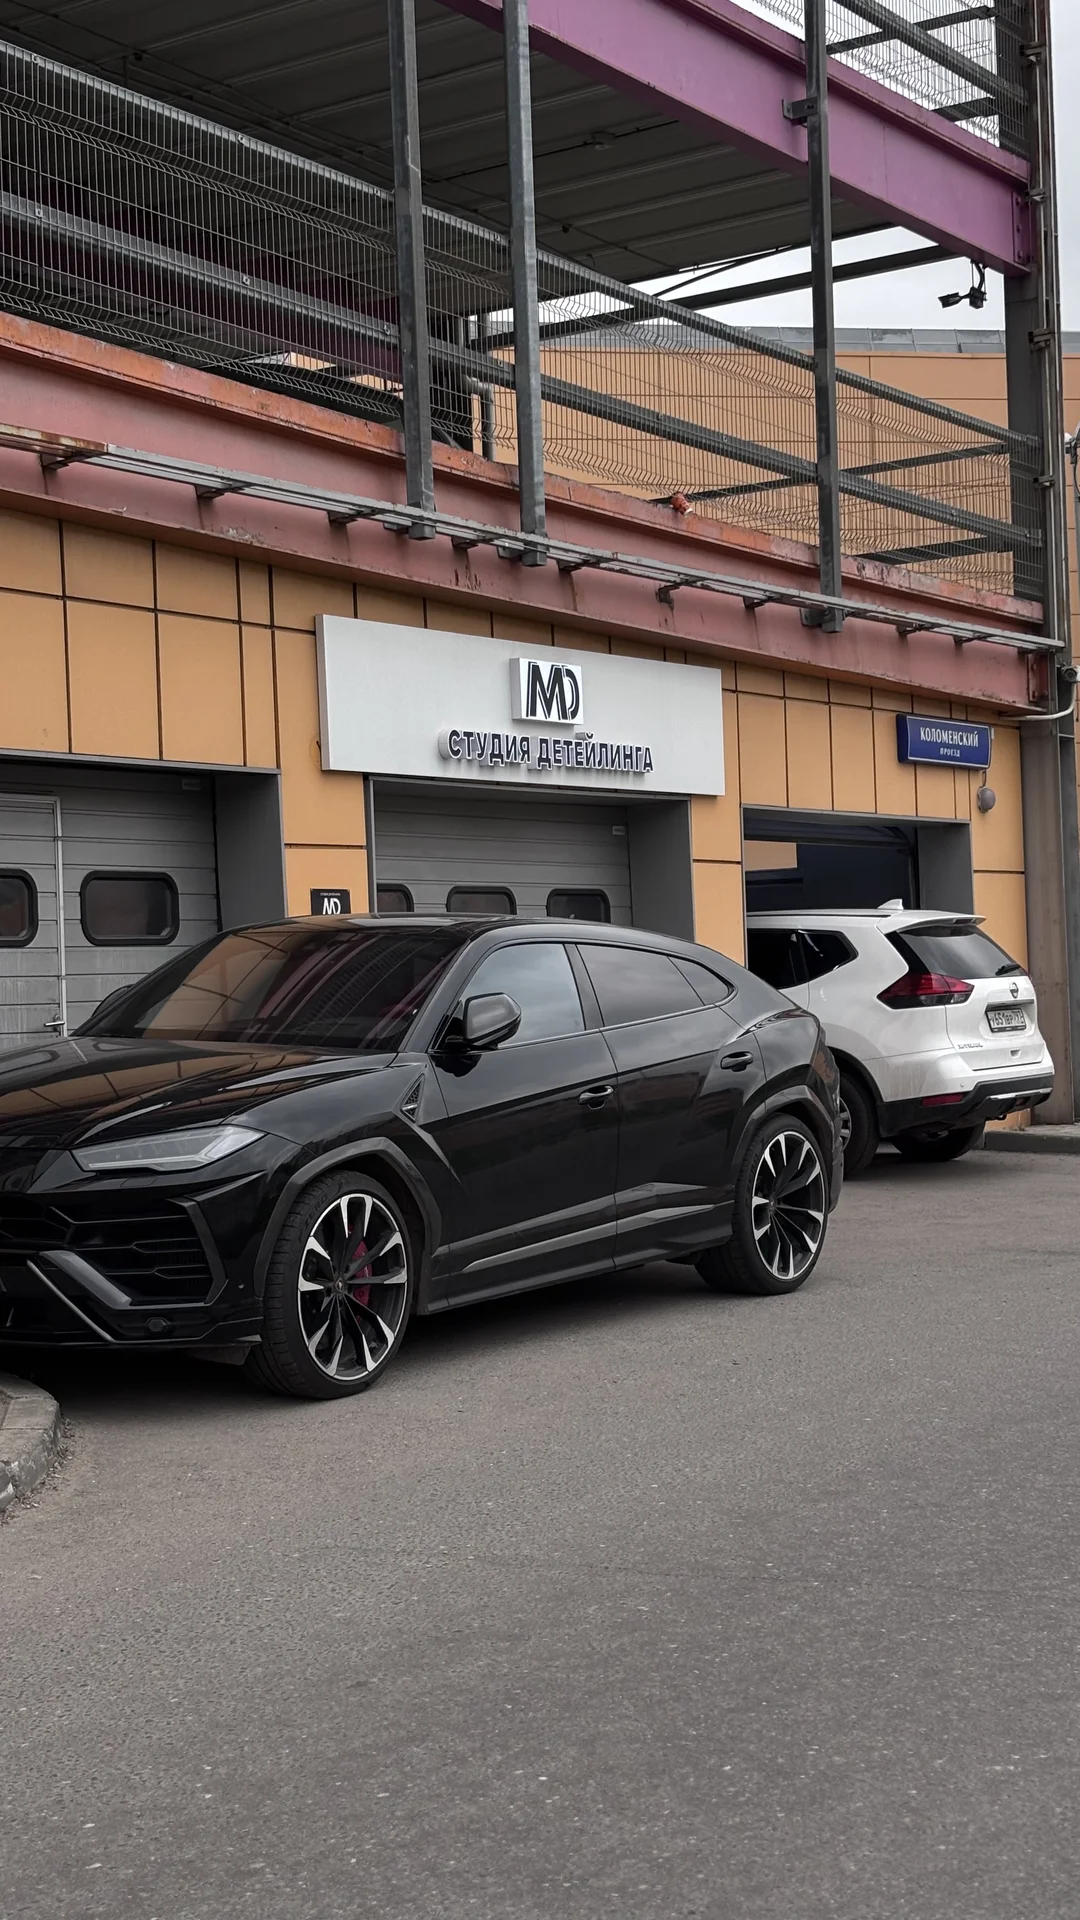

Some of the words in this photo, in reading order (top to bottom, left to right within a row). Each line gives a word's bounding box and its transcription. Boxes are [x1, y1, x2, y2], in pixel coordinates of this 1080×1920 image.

[920, 727, 978, 747] КОЛОМЕНСКИЙ
[447, 729, 531, 767] СТУДИЯ
[537, 732, 654, 772] ДЕТЕЙЛИНГА
[940, 748, 960, 757] ПРОЕЗД
